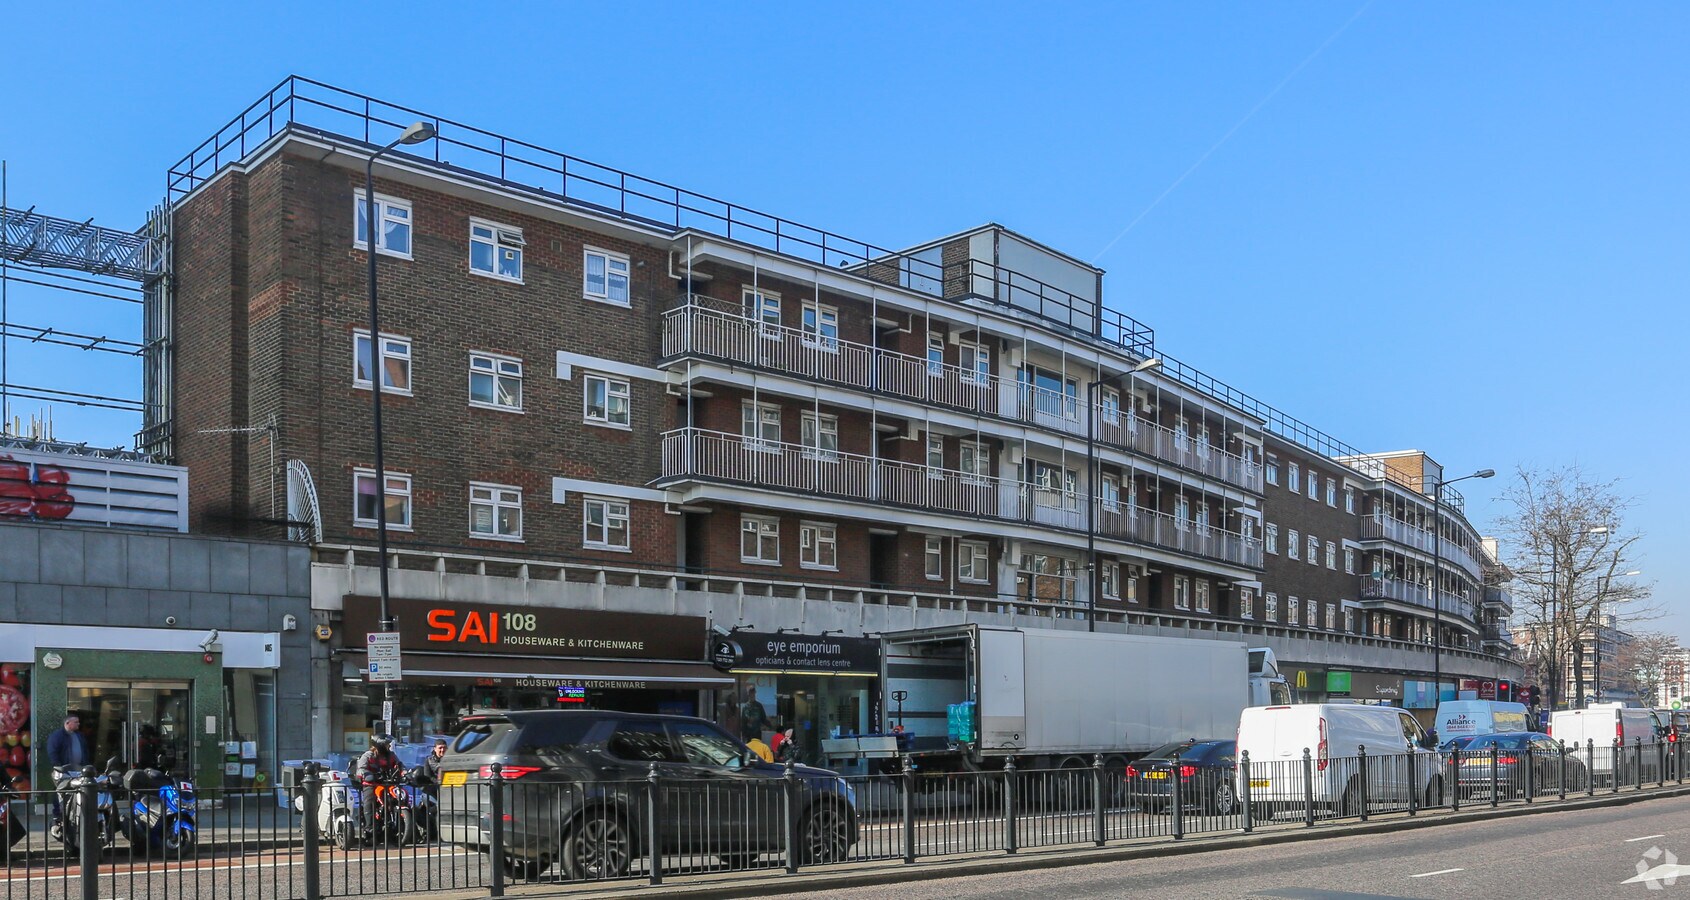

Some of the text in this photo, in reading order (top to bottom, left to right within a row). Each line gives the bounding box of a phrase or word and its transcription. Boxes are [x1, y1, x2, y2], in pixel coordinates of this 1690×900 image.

[427, 609, 537, 643] SAI 108
[503, 636, 644, 650] HOUSEWARE & KITCHENWARE
[767, 640, 841, 657] eye emporium
[371, 664, 377, 672] P
[755, 657, 785, 666] opticians
[786, 657, 792, 666] &
[793, 658, 816, 666] contact
[817, 659, 831, 667] lens
[477, 677, 493, 686] SAI
[515, 678, 573, 687] HOUSEWARE
[575, 680, 582, 688] &
[585, 680, 646, 689] KITCHENWARE
